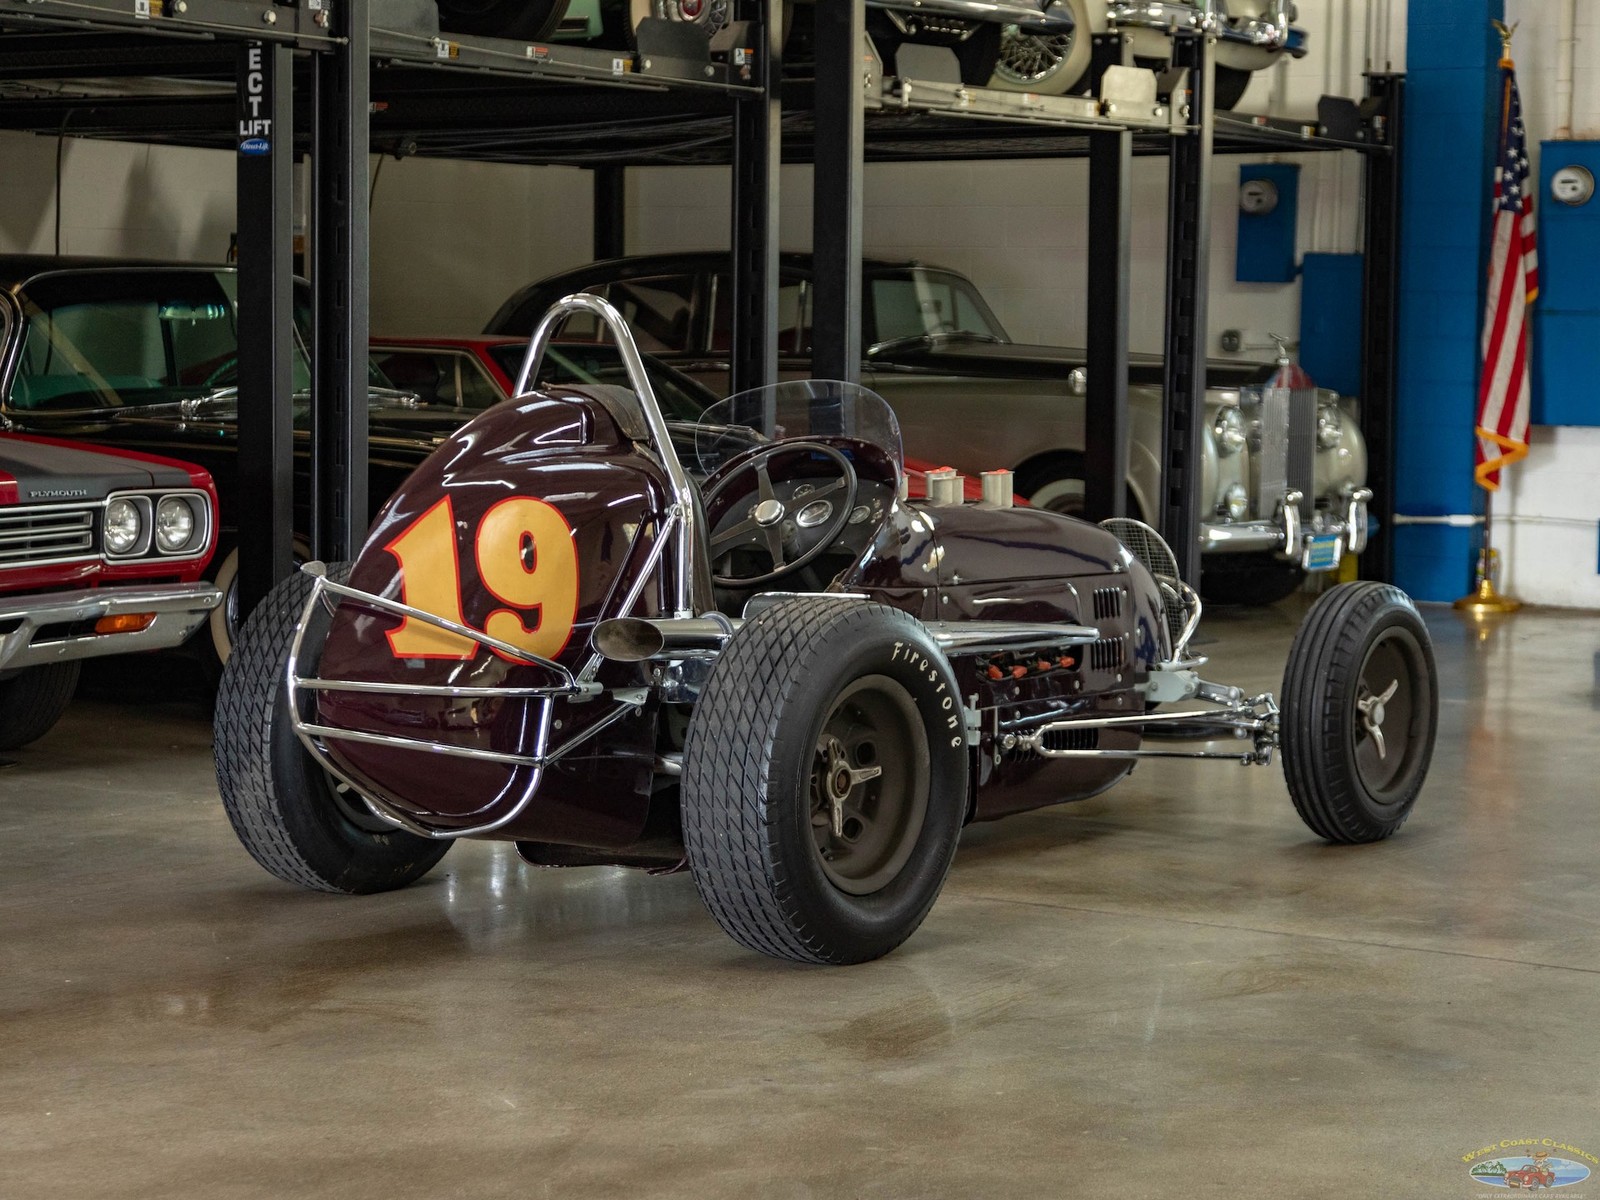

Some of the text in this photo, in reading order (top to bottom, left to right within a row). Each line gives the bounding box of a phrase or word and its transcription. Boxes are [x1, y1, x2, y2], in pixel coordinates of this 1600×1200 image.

[239, 119, 272, 136] LIFT
[29, 489, 88, 498] PLYMOUTH
[383, 494, 580, 666] 19
[891, 641, 962, 748] Firestone
